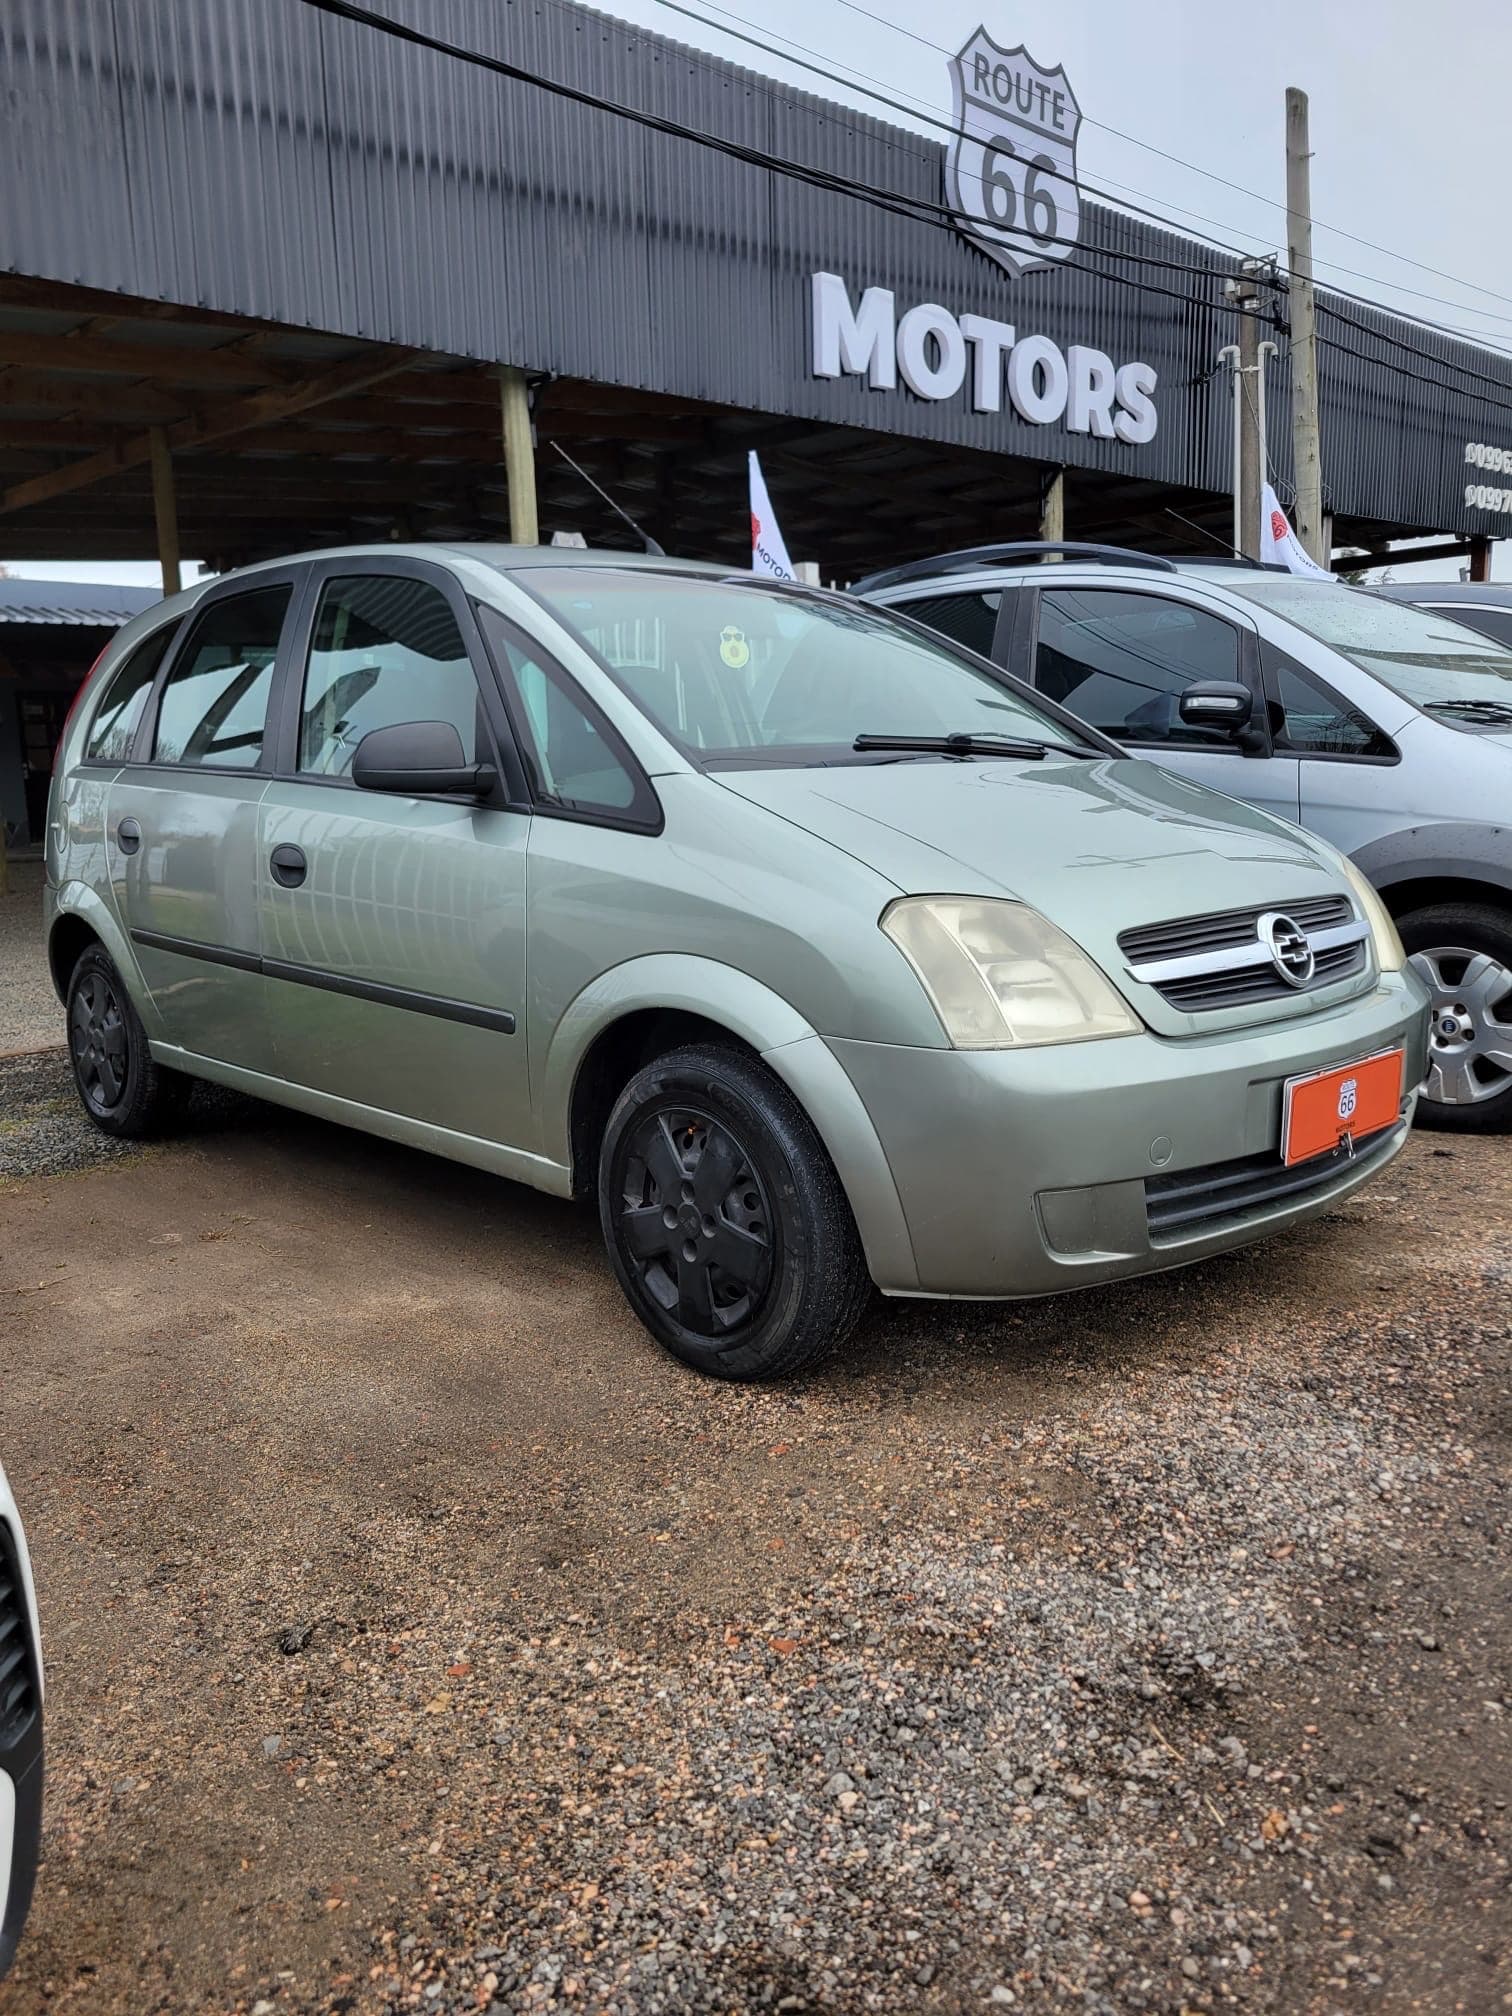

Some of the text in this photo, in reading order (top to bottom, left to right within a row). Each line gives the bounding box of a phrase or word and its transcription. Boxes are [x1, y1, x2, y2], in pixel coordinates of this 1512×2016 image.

[974, 51, 1065, 131] ROUTE
[981, 135, 1058, 249] 66
[811, 271, 1158, 444] MOTORS
[1476, 443, 1512, 474] 0996
[1476, 485, 1512, 514] 0997
[1340, 1093, 1354, 1113] 66
